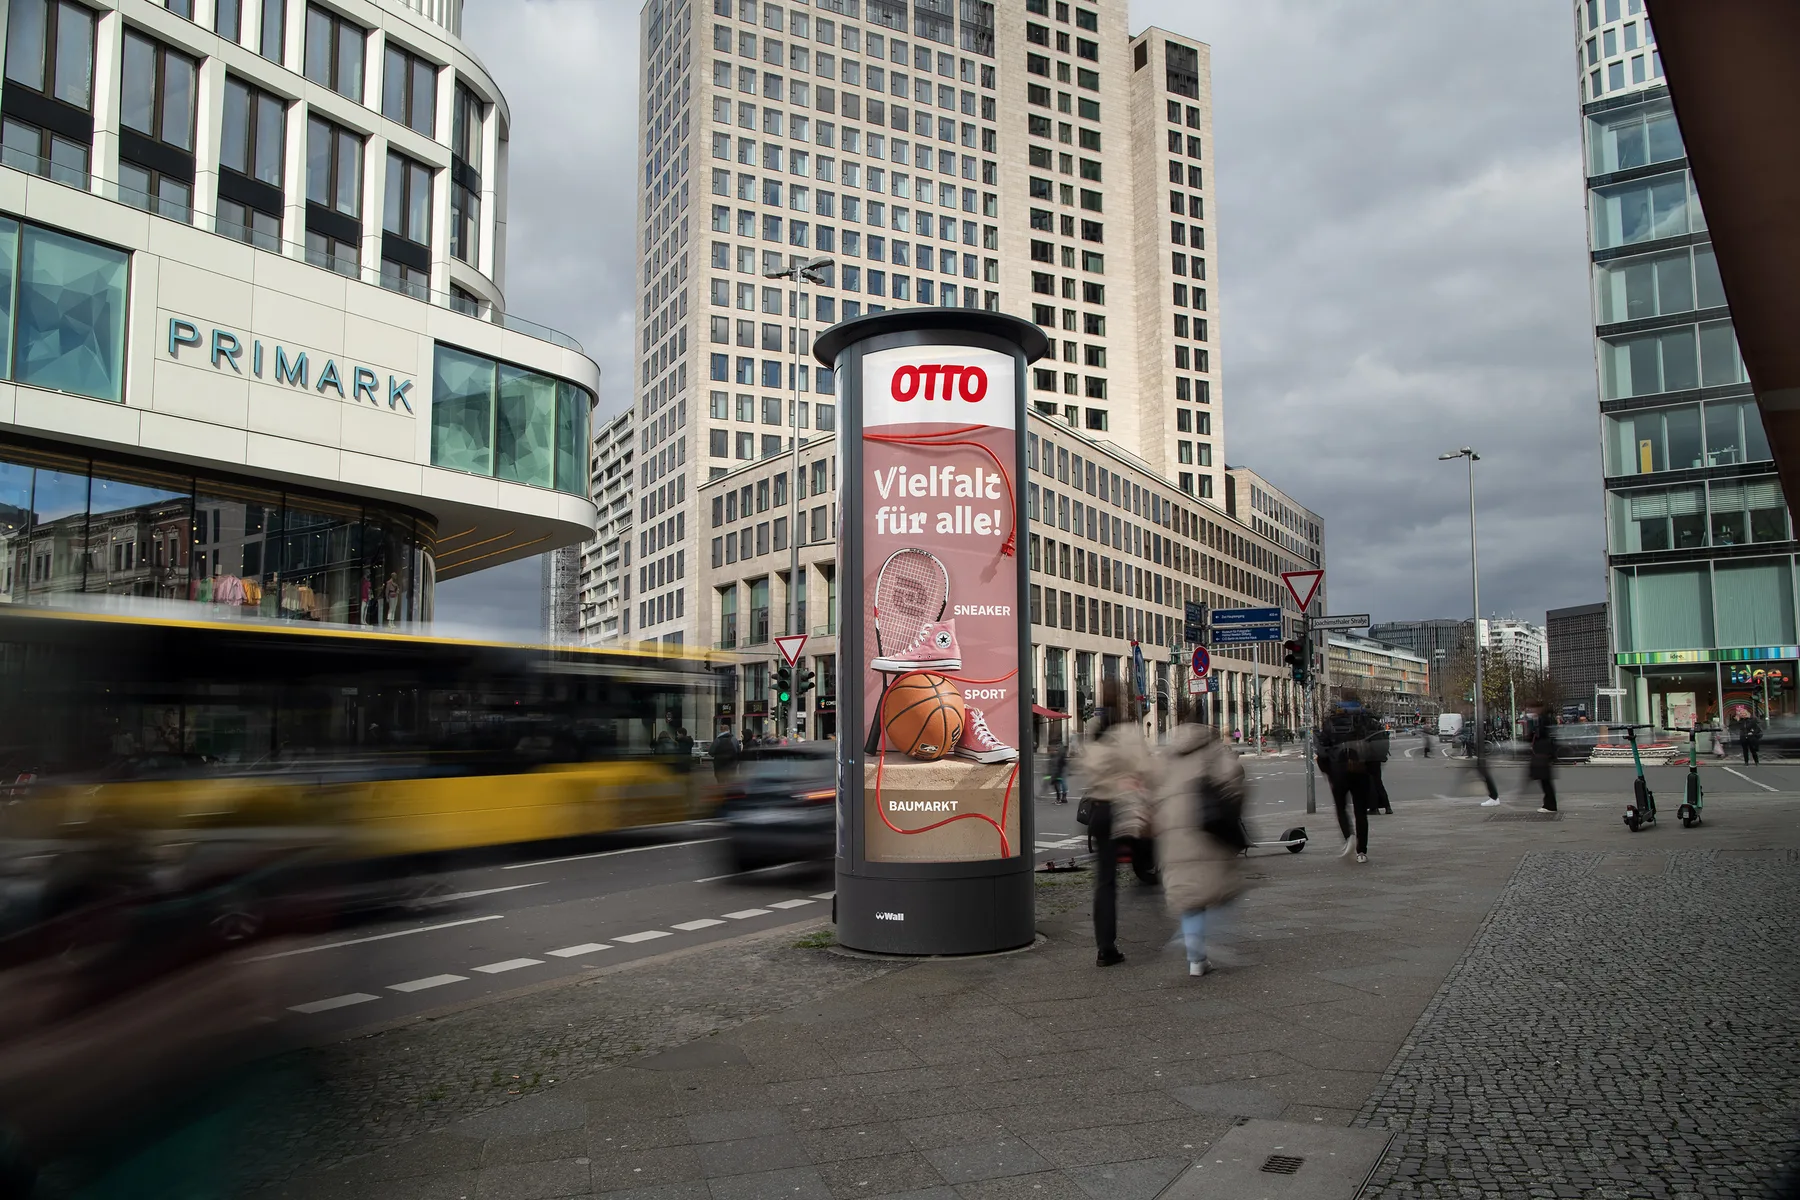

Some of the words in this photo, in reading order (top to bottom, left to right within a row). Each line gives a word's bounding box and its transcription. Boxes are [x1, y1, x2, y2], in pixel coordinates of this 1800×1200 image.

[168, 317, 416, 412] PRIMARK
[891, 364, 988, 403] OTTO
[873, 465, 1001, 500] Vielfalt
[875, 505, 928, 535] für
[935, 505, 1002, 536] alle!
[953, 603, 1011, 617] SNEAKER
[1313, 618, 1350, 627] Joachimsthaler
[1351, 617, 1368, 625] Straße
[964, 688, 1007, 700] SPORT
[888, 800, 959, 813] BAUMARKT
[884, 911, 905, 921] Wall
